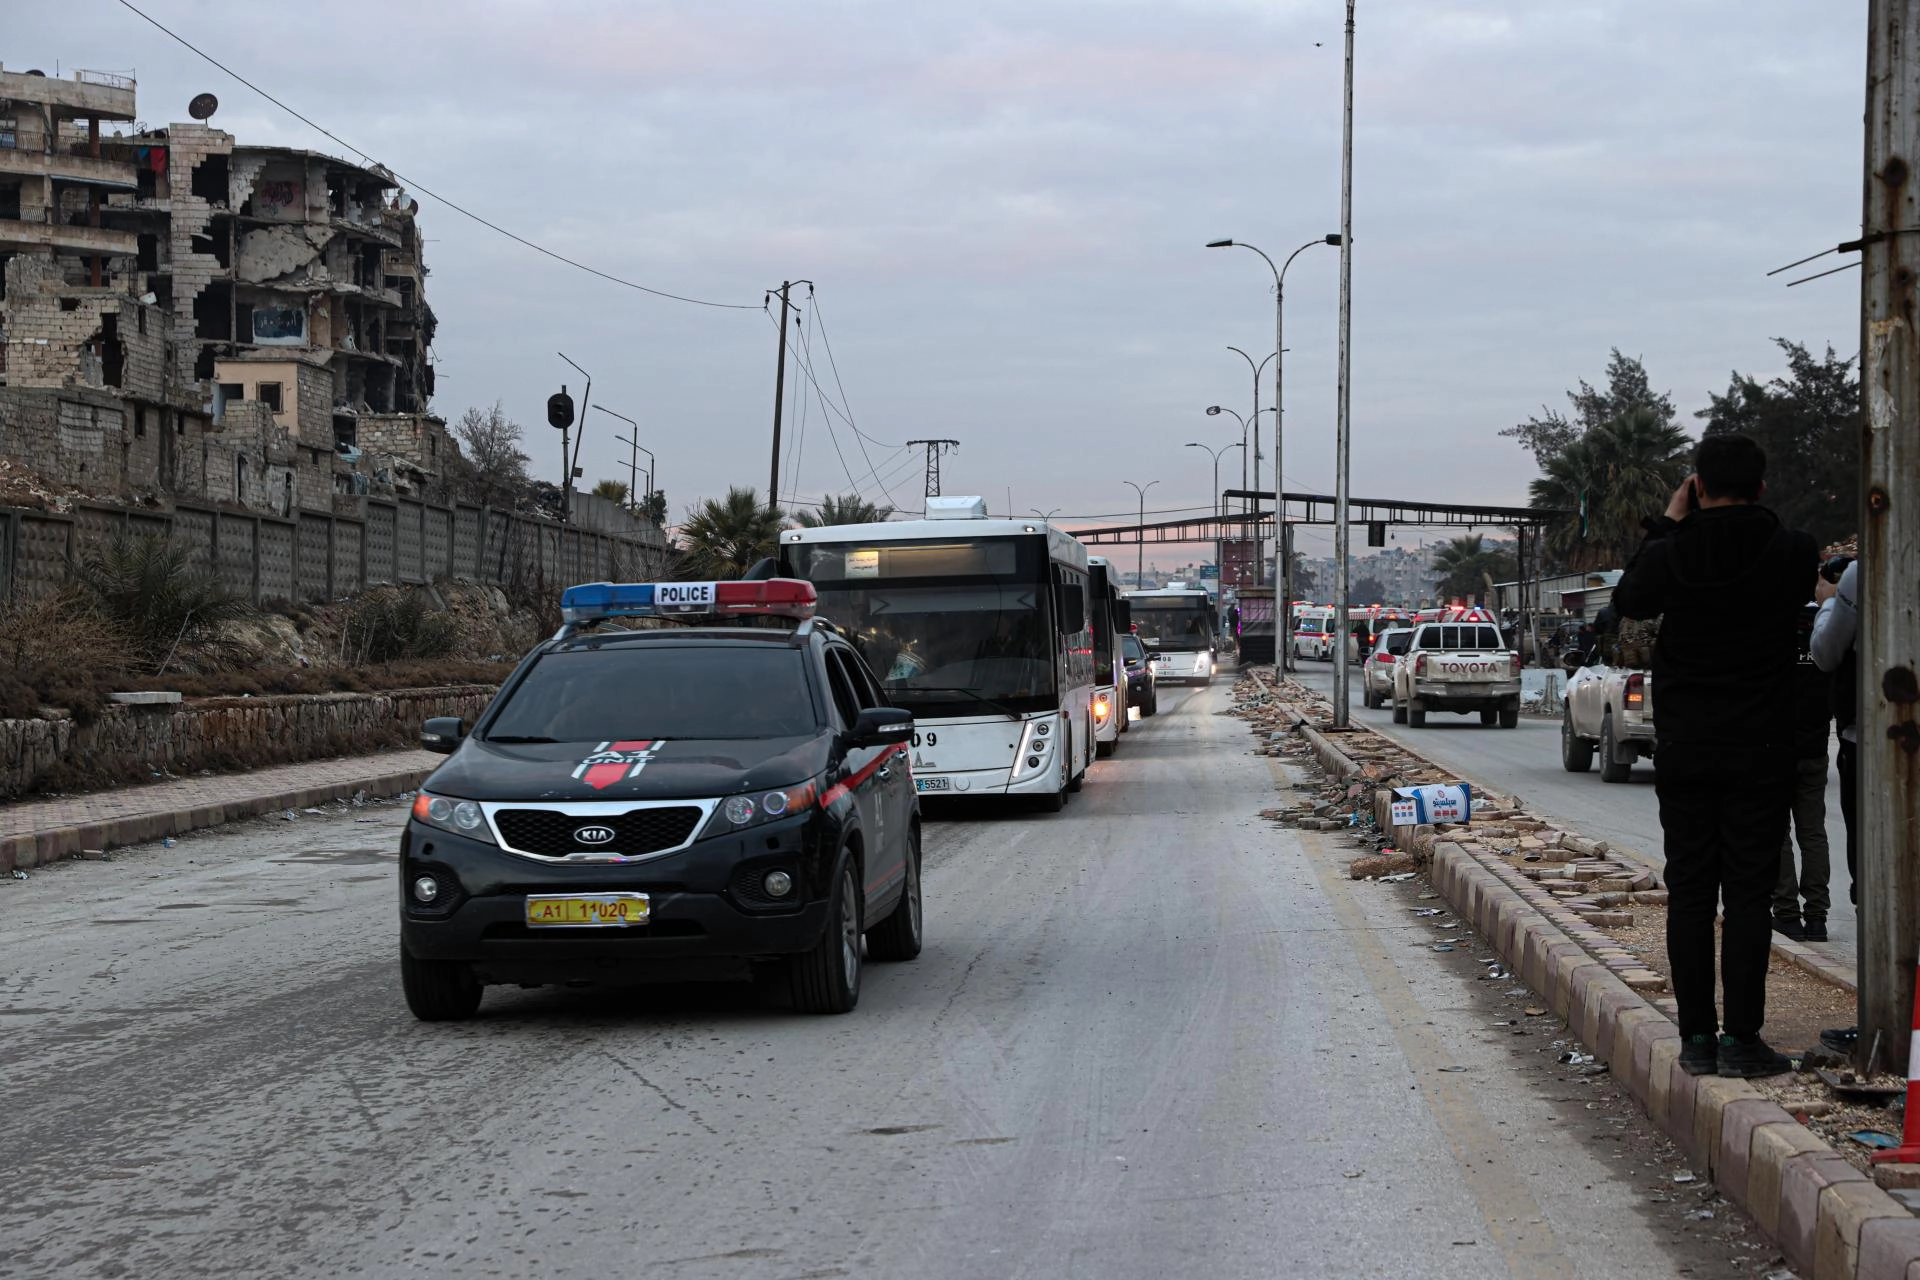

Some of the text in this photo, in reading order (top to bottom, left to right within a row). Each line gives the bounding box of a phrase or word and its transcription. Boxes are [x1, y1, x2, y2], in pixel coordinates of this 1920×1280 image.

[661, 586, 709, 602] POLICE
[1440, 662, 1498, 674] TOYOTA
[582, 830, 607, 840] KIA
[543, 905, 562, 919] A1
